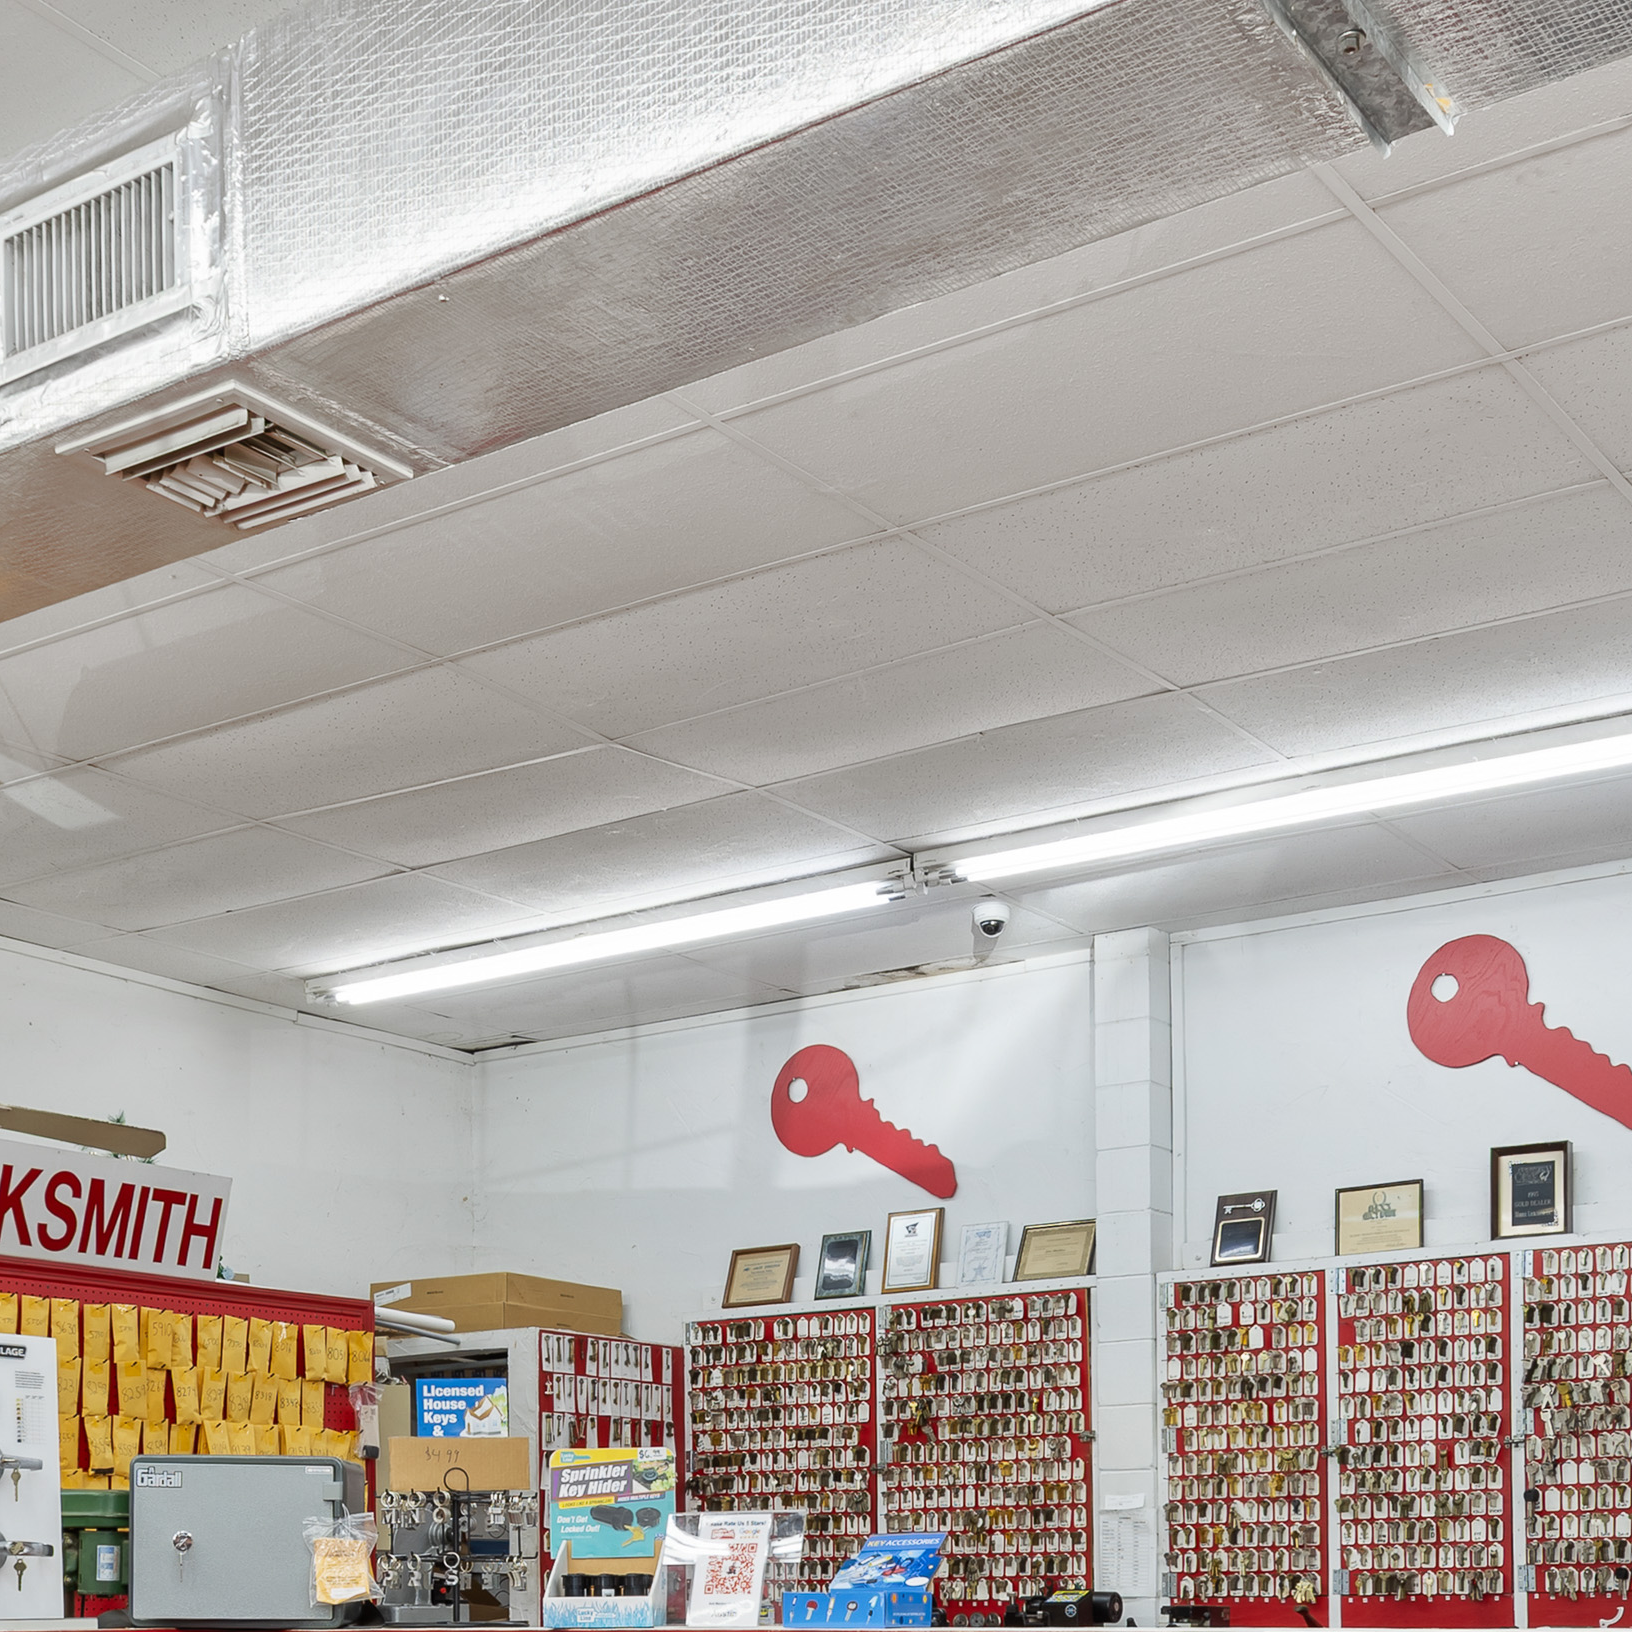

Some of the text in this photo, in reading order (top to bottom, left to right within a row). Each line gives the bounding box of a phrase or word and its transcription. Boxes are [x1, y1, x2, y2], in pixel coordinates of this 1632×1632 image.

[422, 1384, 485, 1398] Licensed
[423, 1398, 467, 1411] House
[423, 1411, 458, 1426] Keys
[432, 1425, 445, 1437] &
[560, 1464, 628, 1484] Sprinkler
[559, 1480, 627, 1499] Key Hider
[560, 1525, 585, 1533] Locked
[739, 1527, 761, 1537] Google
